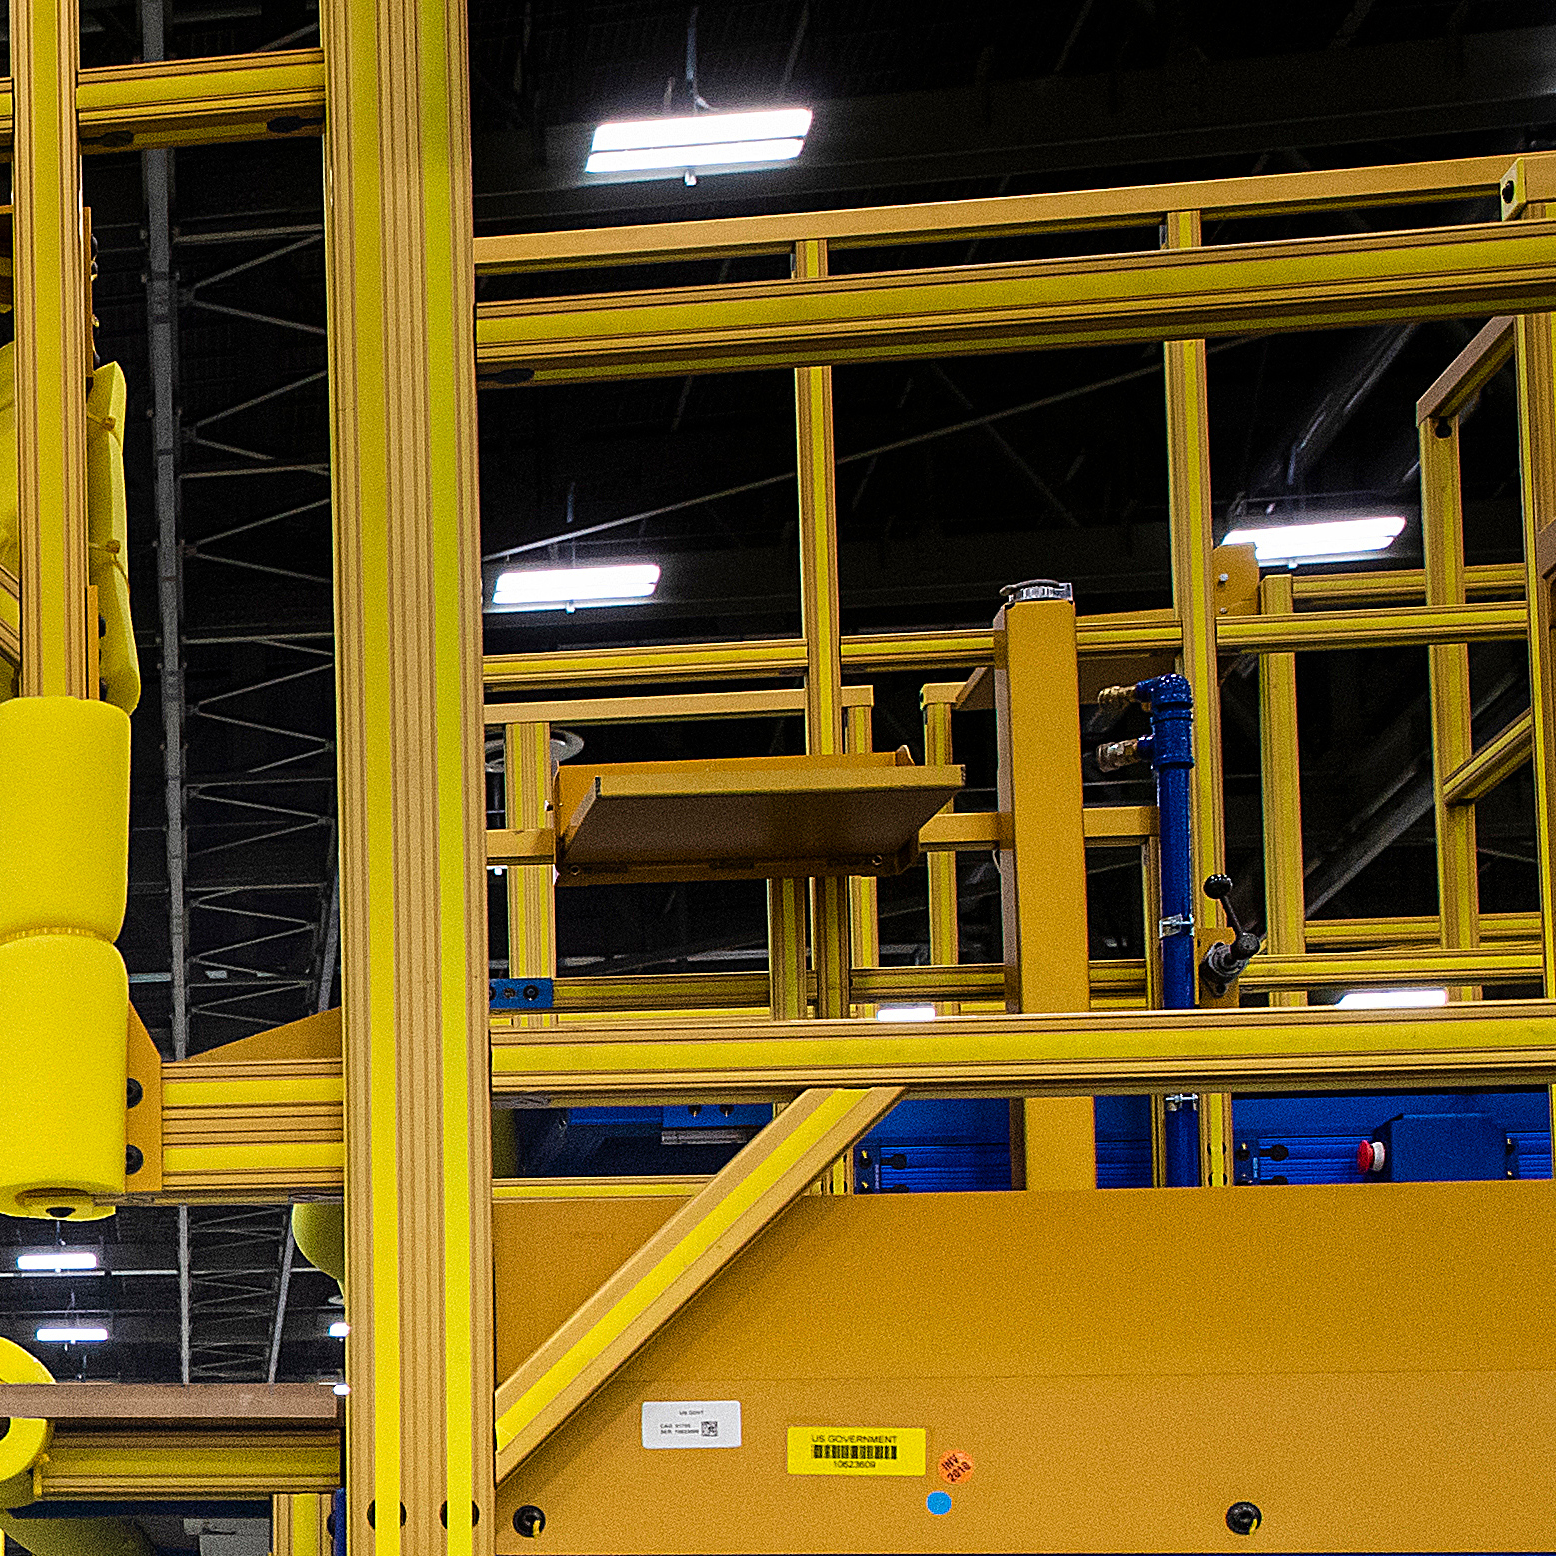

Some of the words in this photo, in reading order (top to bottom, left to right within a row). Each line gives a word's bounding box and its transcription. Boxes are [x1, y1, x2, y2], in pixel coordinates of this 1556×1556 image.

[811, 1435, 825, 1443] US
[827, 1435, 897, 1444] GOVERNMENT
[941, 1453, 959, 1471] INV
